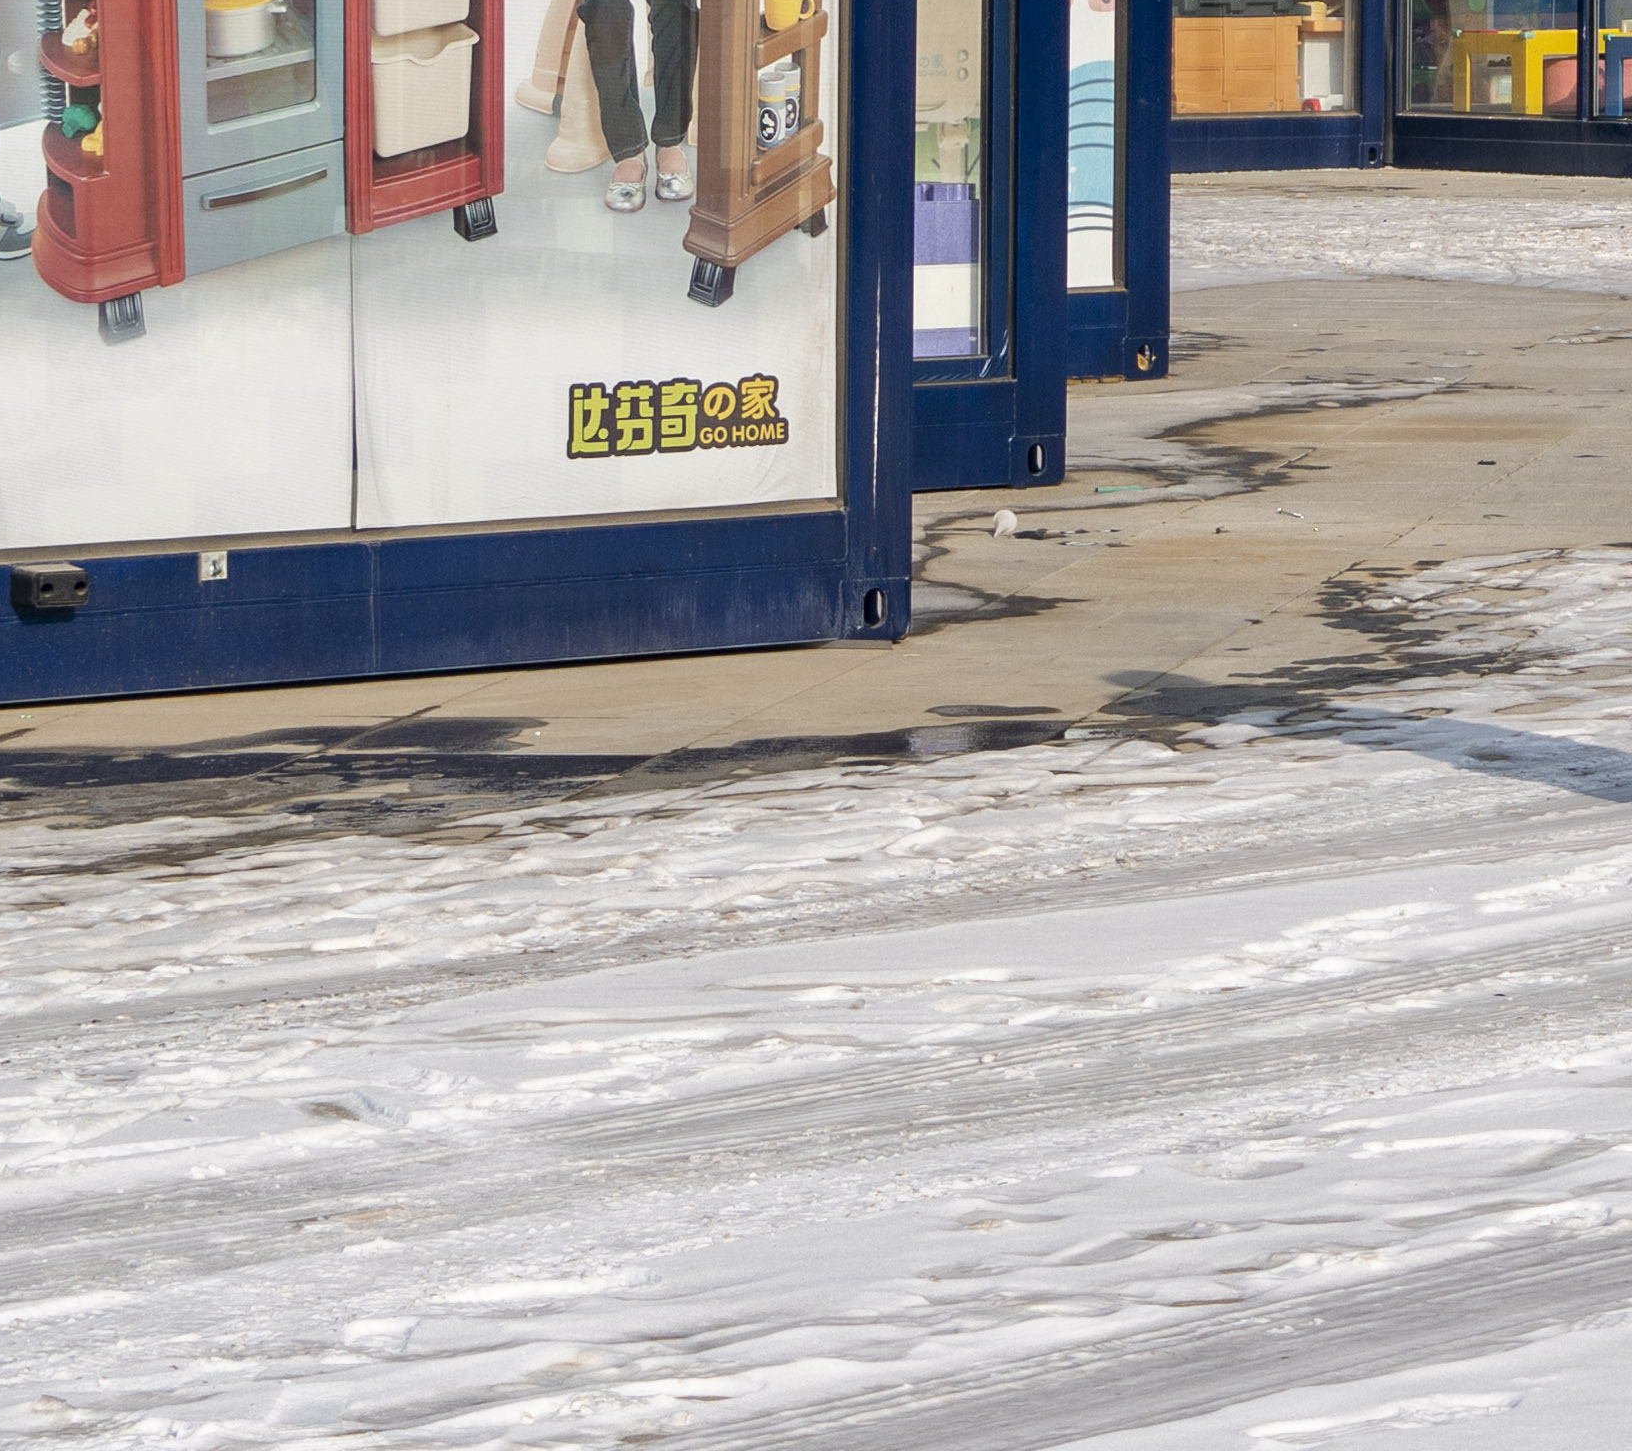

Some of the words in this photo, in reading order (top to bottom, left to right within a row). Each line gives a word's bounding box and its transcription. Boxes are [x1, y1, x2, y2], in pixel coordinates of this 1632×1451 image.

[571, 378, 779, 454] 达芬奇の家
[700, 424, 728, 445] GO
[732, 421, 785, 443] HOME
